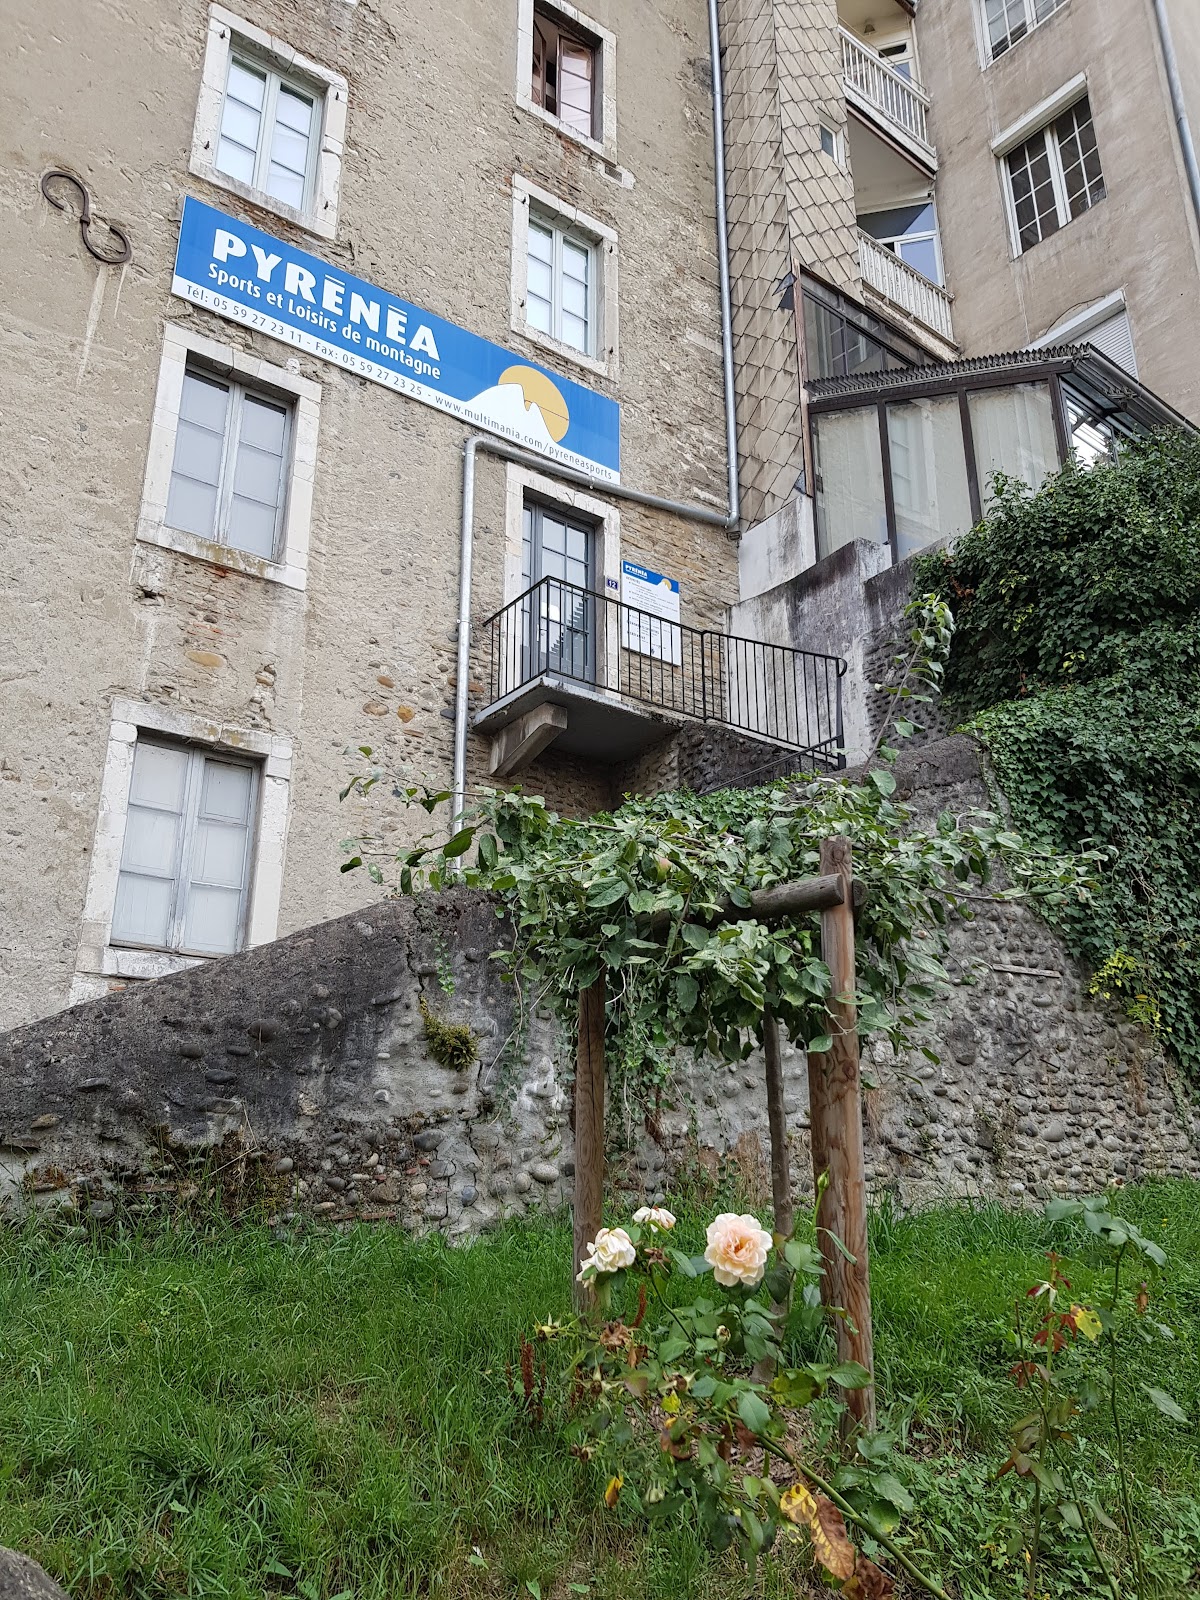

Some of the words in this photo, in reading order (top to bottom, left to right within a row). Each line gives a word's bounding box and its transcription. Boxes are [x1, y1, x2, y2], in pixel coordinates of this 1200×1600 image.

[208, 263, 260, 298] Sports
[266, 291, 283, 308] et
[289, 299, 336, 332] Loisirs
[342, 323, 361, 343] de
[366, 336, 441, 380] montagne
[187, 284, 208, 302] Tél:
[213, 298, 227, 311] 05
[233, 306, 247, 318] 59
[252, 314, 265, 327] 27
[271, 322, 284, 335] 23
[290, 331, 302, 343] 11
[315, 343, 338, 360] Fax:
[342, 353, 355, 366] 05
[360, 360, 372, 373] 59
[377, 367, 390, 380] 27
[393, 374, 406, 387] 23
[410, 382, 422, 395] 25
[435, 395, 612, 480] www.multimania.com/pyreneasports
[608, 580, 616, 588] 12
